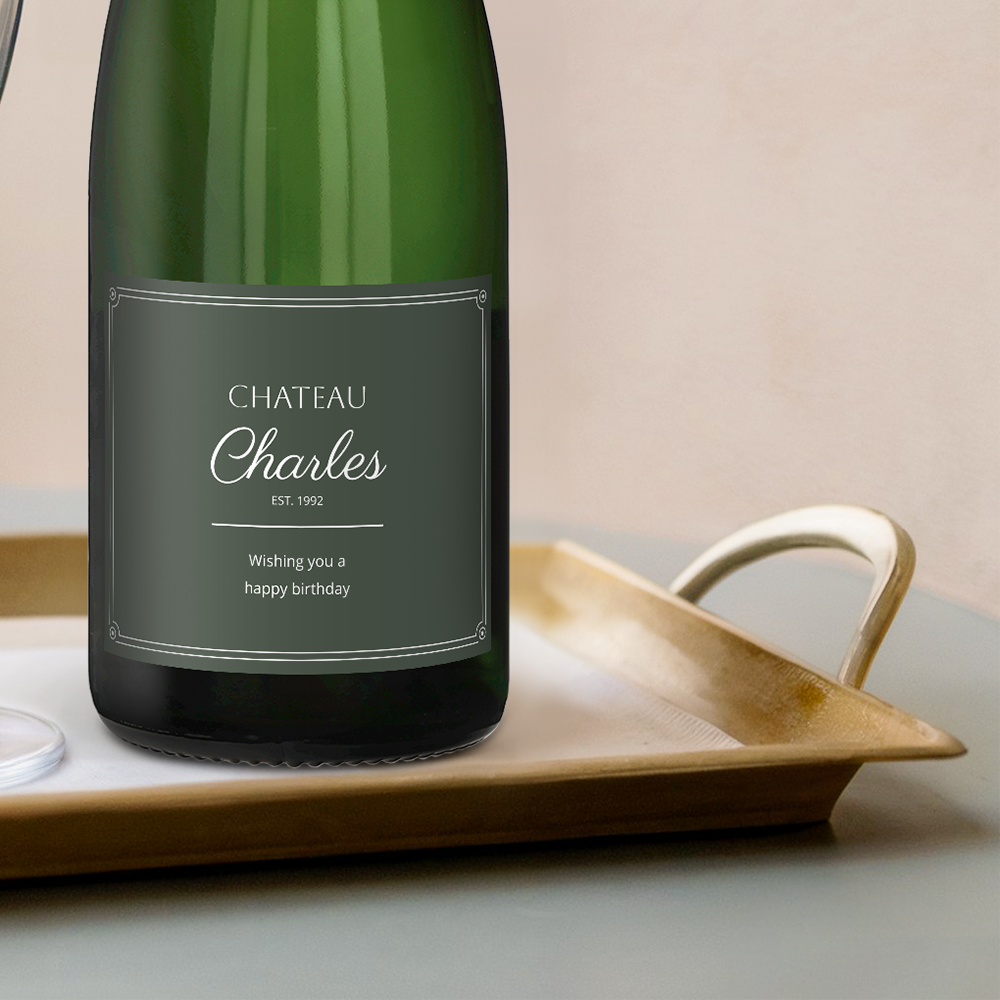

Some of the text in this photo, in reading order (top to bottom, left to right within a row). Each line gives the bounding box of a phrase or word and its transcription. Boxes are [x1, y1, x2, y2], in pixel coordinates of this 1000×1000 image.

[228, 384, 366, 409] CHATEAU
[210, 426, 387, 485] Charles
[271, 495, 324, 507] EST. 1992
[248, 553, 346, 572] Wishing you a
[244, 580, 351, 600] happy birthday
